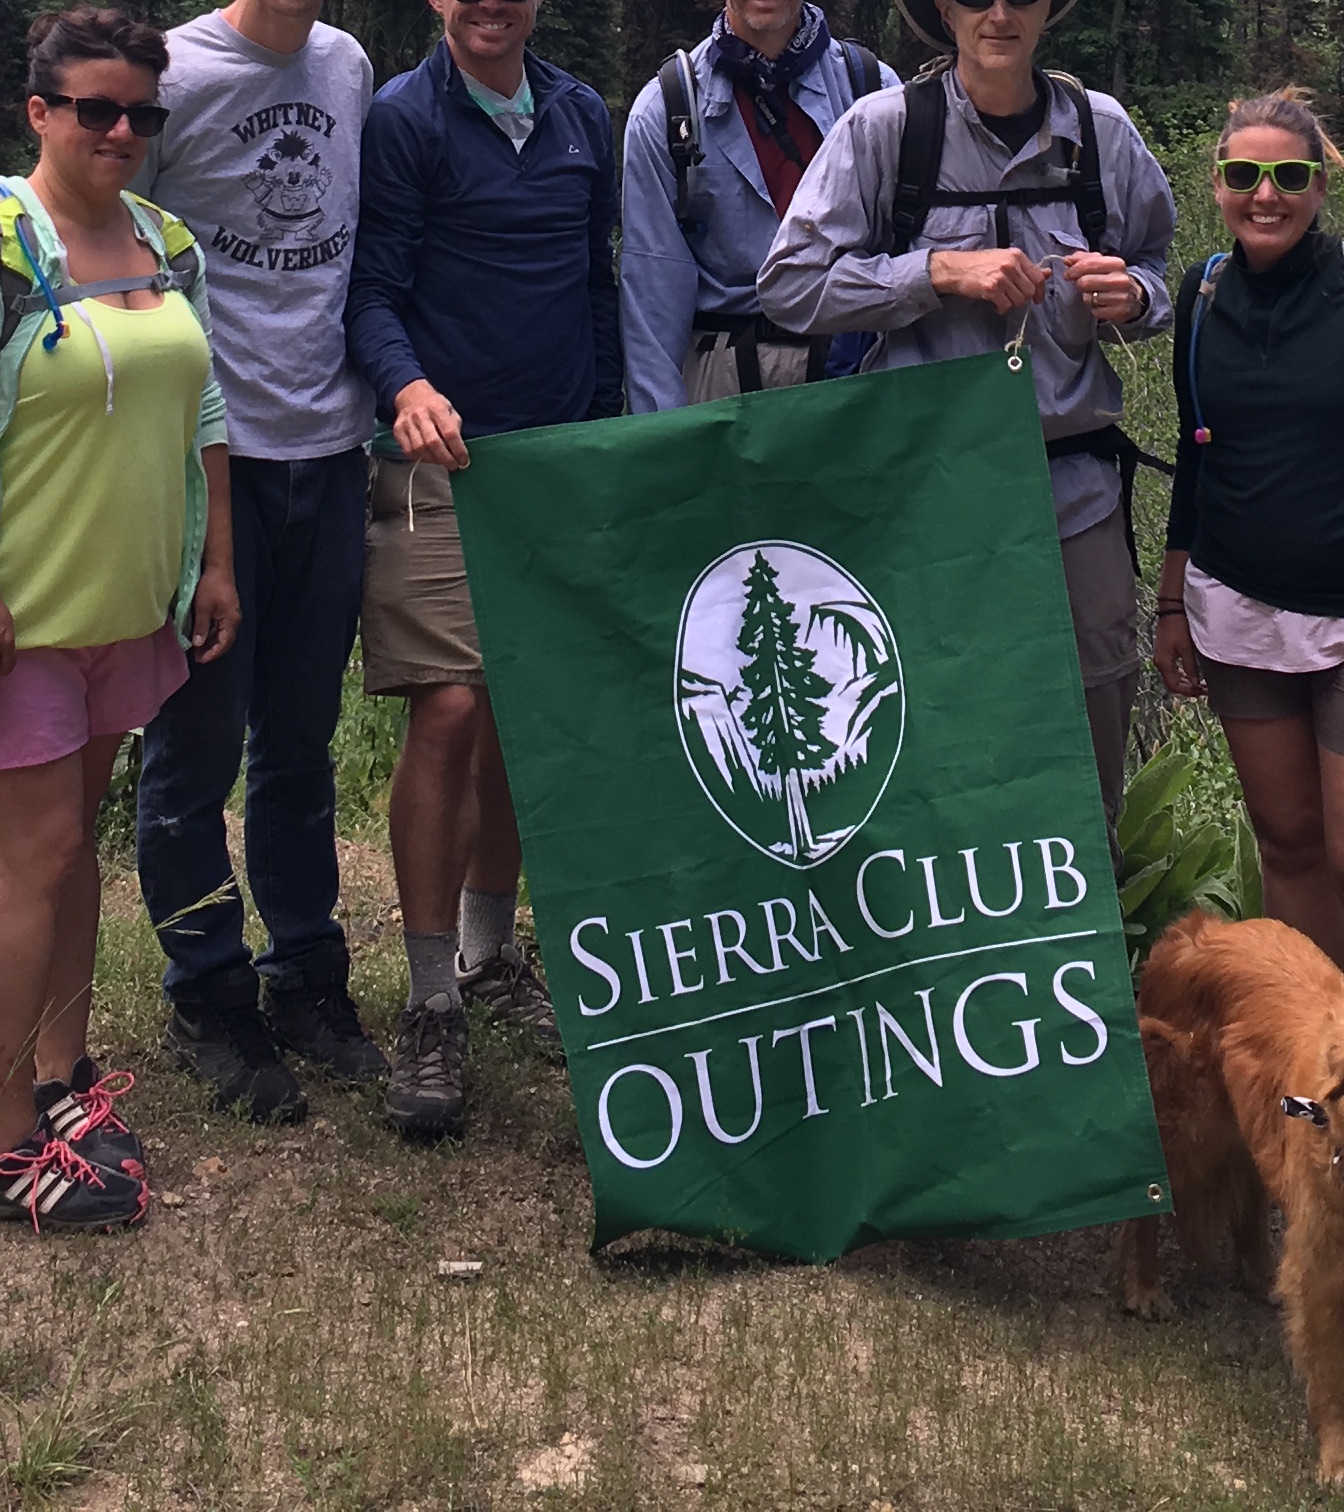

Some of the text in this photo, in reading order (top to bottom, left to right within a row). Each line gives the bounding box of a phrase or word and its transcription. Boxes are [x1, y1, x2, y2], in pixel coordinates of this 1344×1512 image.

[231, 102, 336, 144] WHITNEY
[756, 95, 777, 125] Canon
[210, 223, 350, 271] WOLVERINES
[569, 836, 1087, 1016] SIERRA CLUB
[598, 960, 1108, 1169] OUTINGS
